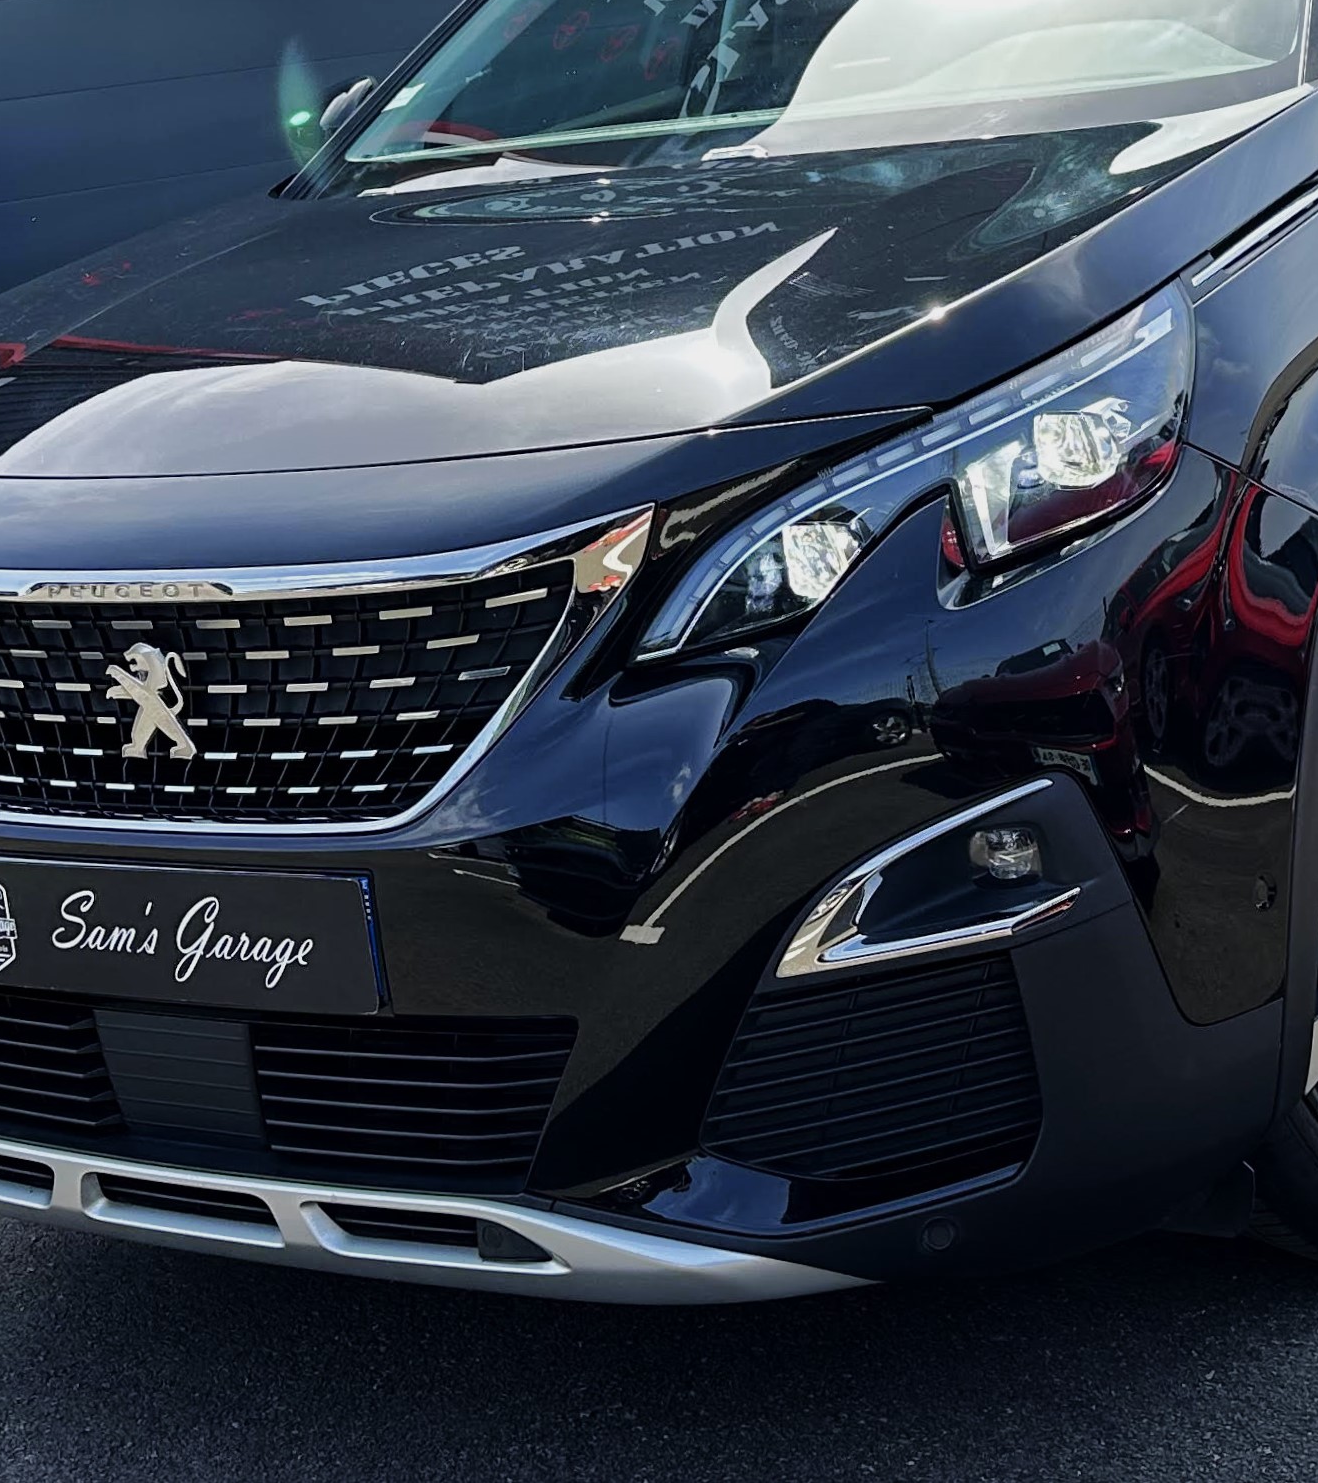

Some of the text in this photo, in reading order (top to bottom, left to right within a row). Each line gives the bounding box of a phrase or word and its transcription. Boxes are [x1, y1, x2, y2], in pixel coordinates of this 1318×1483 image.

[47, 582, 205, 598] PEUGEOT
[52, 890, 314, 989] Sam's Garage
